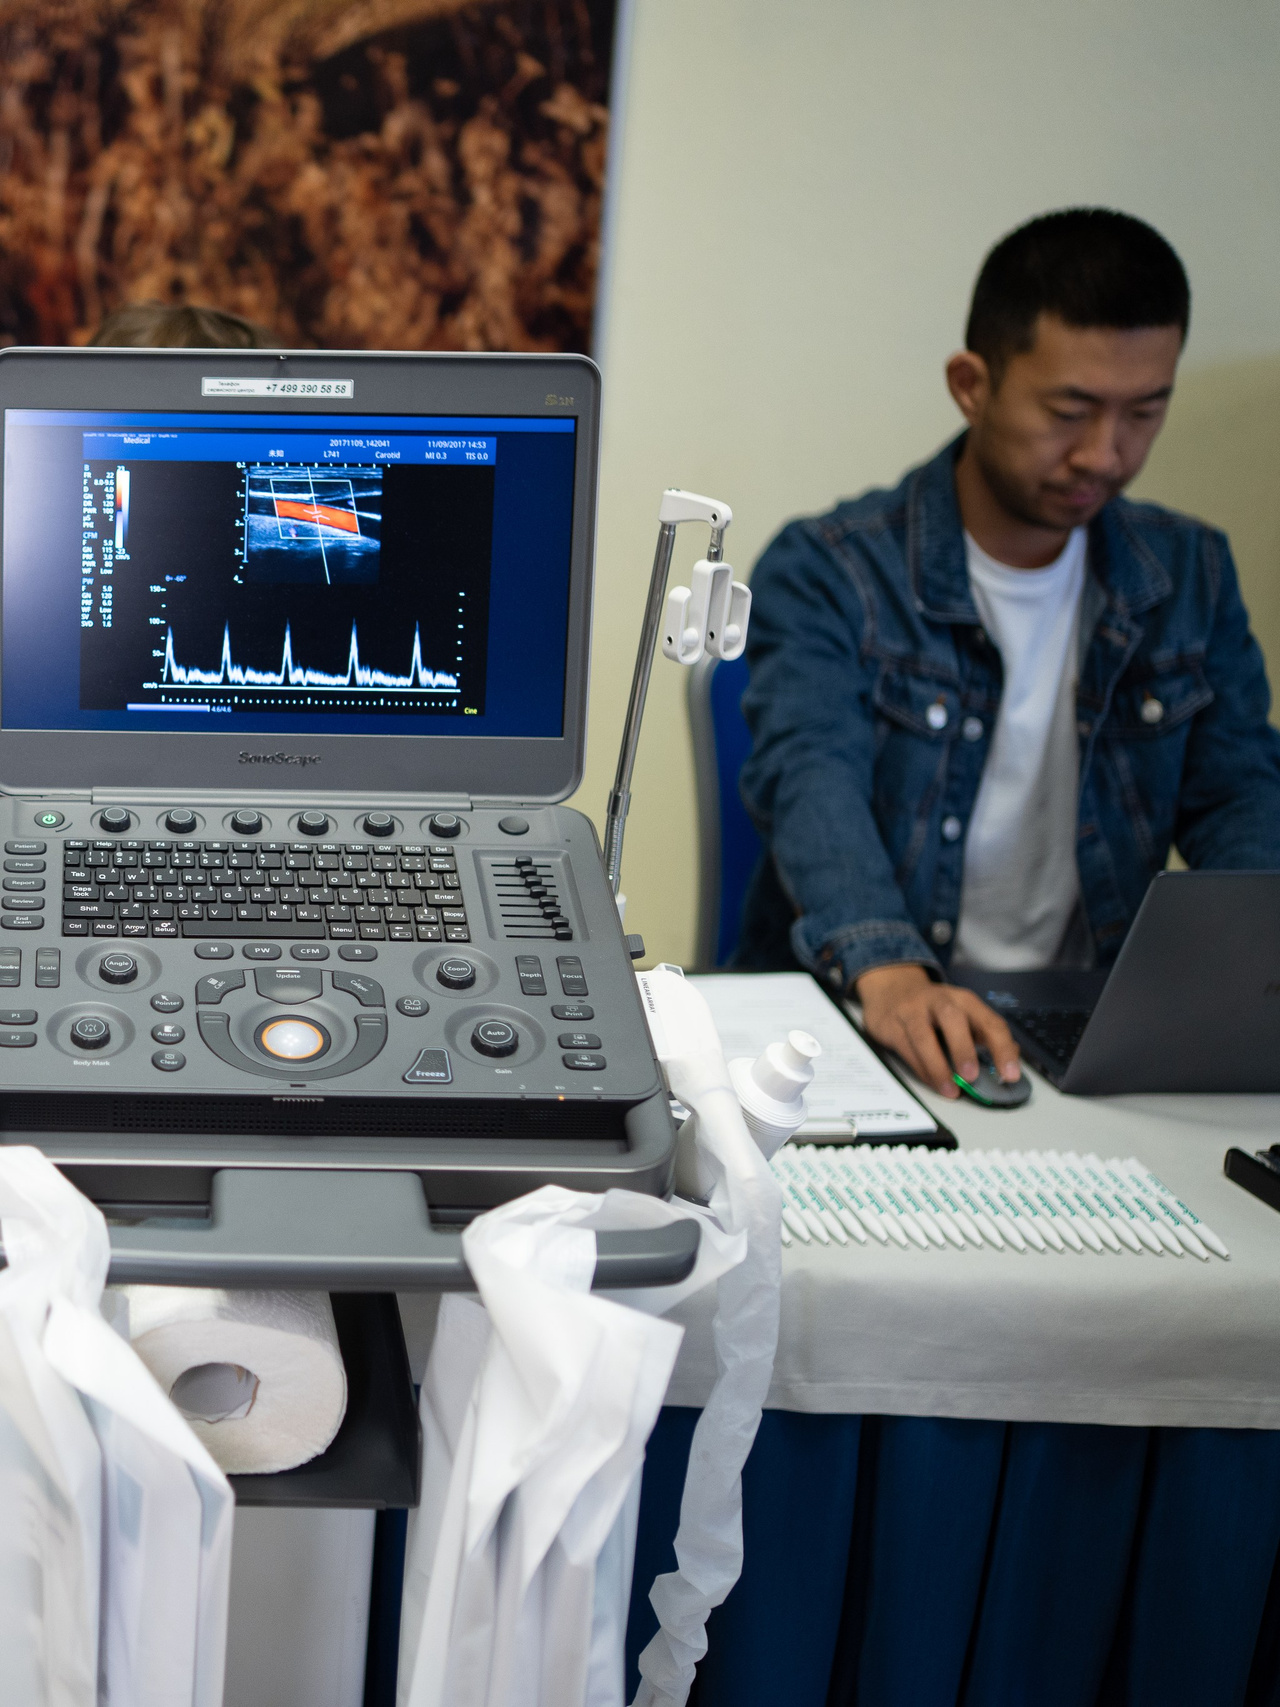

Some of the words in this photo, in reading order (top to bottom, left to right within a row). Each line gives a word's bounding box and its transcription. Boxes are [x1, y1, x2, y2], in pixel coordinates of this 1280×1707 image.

[266, 384, 277, 392] +7
[280, 384, 298, 393] 499
[300, 385, 318, 393] 390
[320, 385, 332, 393] 58
[335, 385, 346, 394] 58
[330, 439, 390, 449] 20171109_142041
[427, 441, 466, 450] 11/09/2017
[468, 441, 487, 449] 14:53
[375, 451, 400, 459] Carotid
[425, 452, 435, 460] MI
[436, 452, 447, 460] 0.3
[464, 707, 478, 715] Cine
[238, 751, 322, 766] SonoScape
[350, 979, 369, 993] Caliper
[416, 1070, 445, 1078] Freeze
